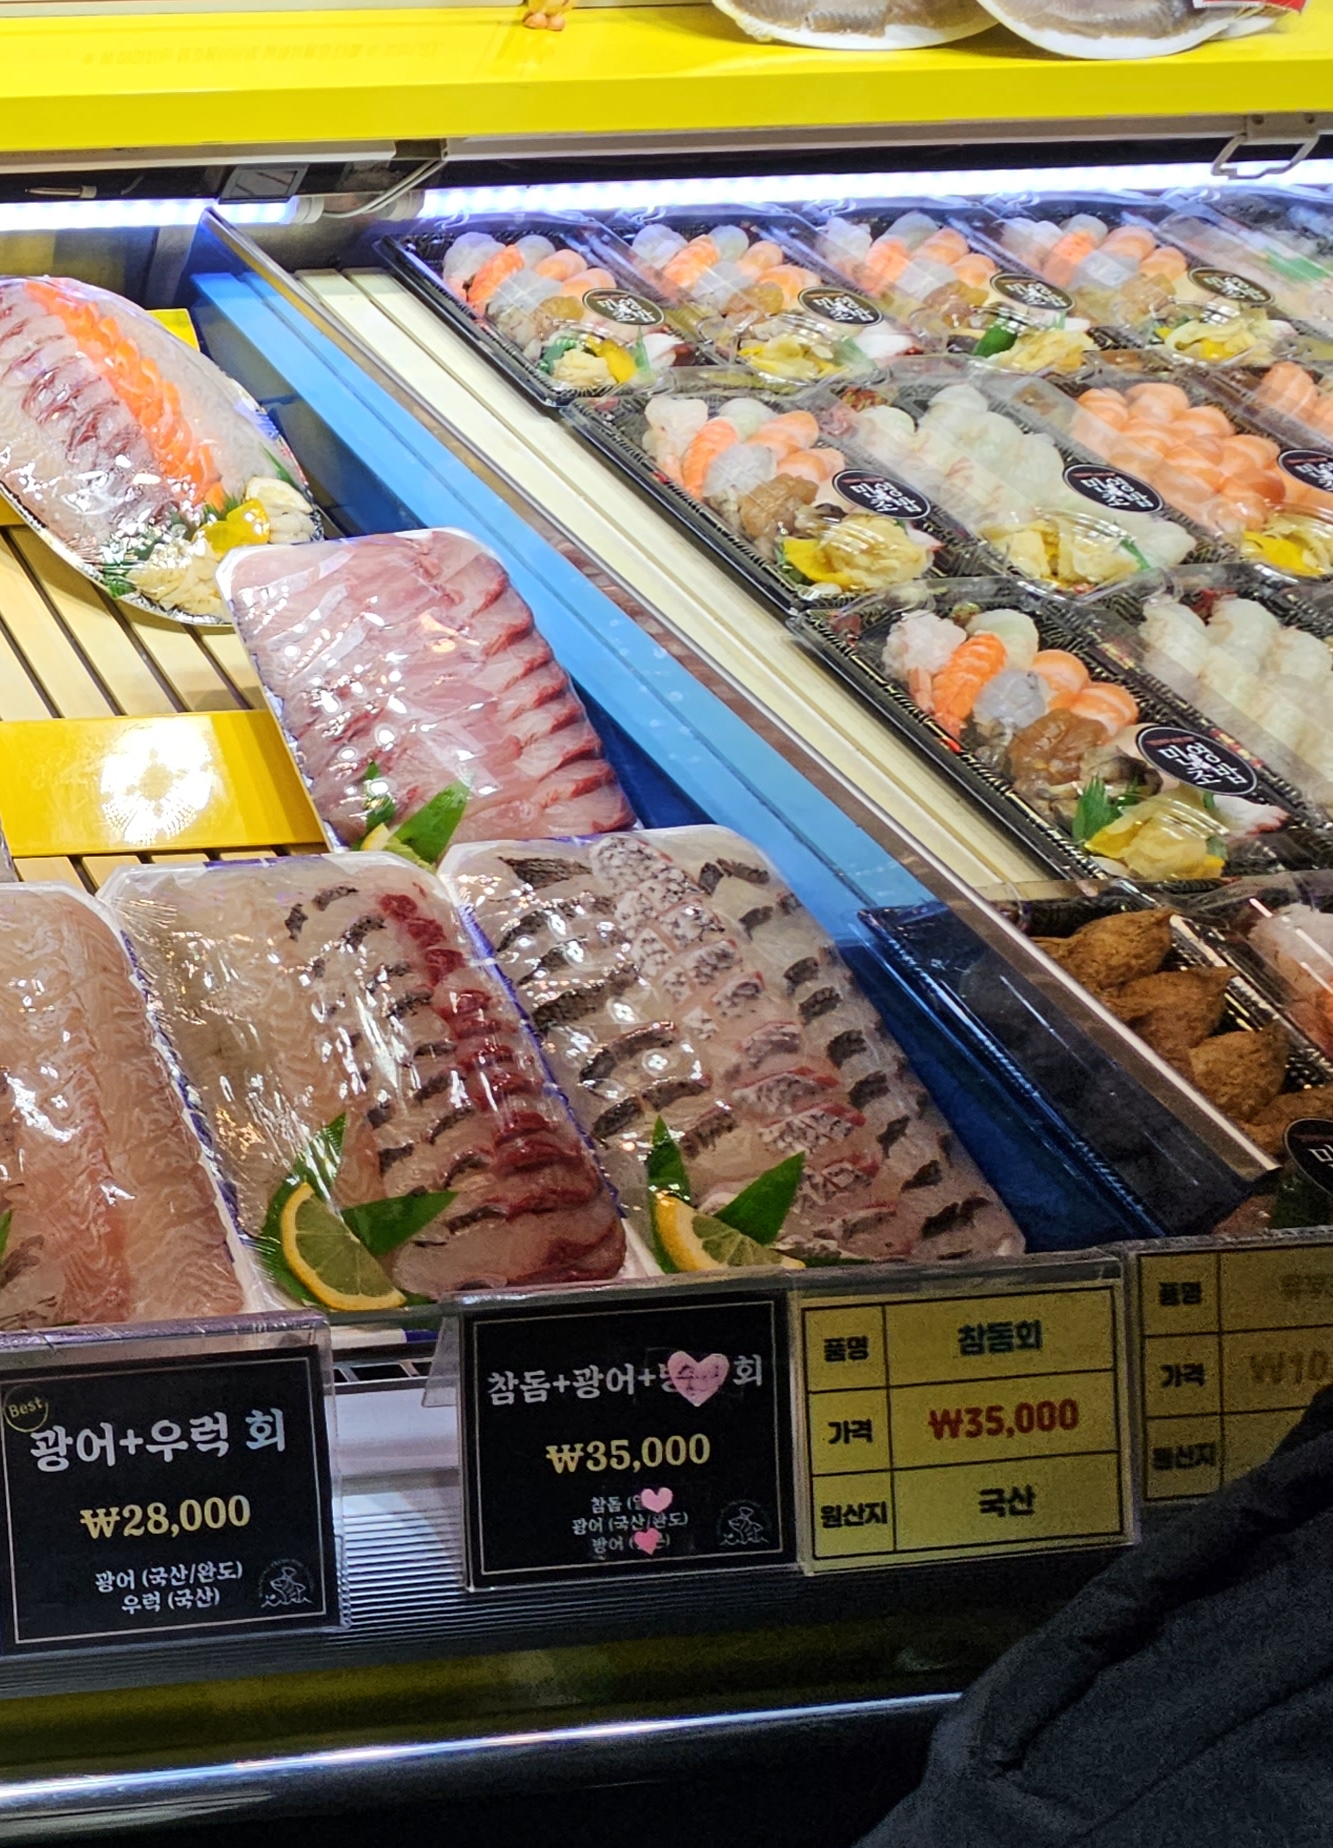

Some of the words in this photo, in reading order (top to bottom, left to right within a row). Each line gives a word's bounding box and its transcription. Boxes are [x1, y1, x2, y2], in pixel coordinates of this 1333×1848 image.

[733, 1353, 762, 1387] 회
[1160, 1362, 1205, 1387] 가격
[9, 1396, 43, 1418] Best
[827, 1418, 874, 1445] 가격
[928, 1398, 1078, 1440] ₩35,000
[30, 1411, 230, 1472] 광어+우럭
[245, 1408, 286, 1452] 회
[546, 1433, 711, 1474] ₩35,000
[80, 1495, 251, 1539] ₩28,000
[820, 1501, 888, 1528] 원산지
[979, 1485, 1036, 1518] 국산
[572, 1516, 603, 1536] 광어
[95, 1568, 135, 1593] 광어
[142, 1561, 244, 1588] (국산/완도)
[122, 1592, 161, 1614] 우럭
[168, 1587, 220, 1610] (국산)
